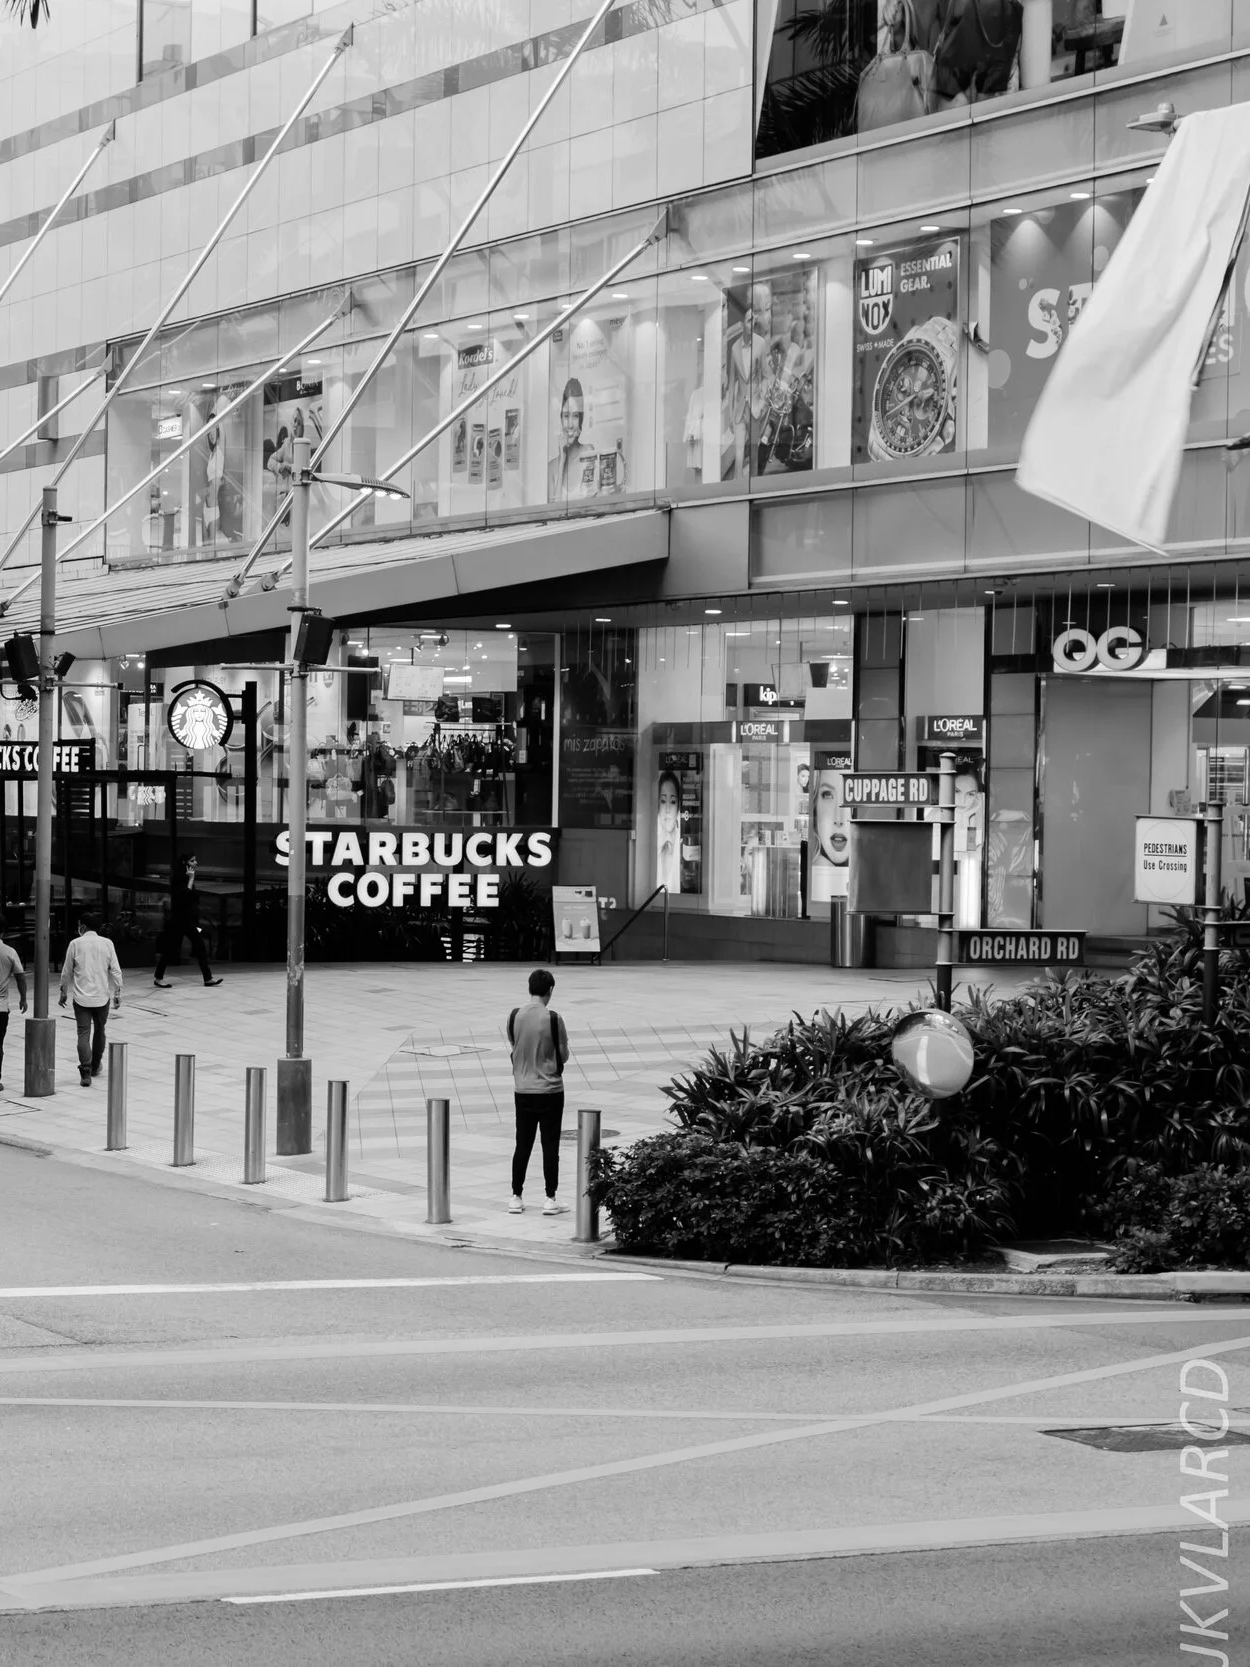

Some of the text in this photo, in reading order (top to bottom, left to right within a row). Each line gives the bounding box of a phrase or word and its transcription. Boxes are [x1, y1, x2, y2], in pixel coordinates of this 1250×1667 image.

[900, 253, 952, 277] ESSENTIAL
[900, 275, 931, 293] GEAR.
[459, 347, 493, 366] Kordel's
[1053, 626, 1142, 672] OG
[24, 745, 80, 772] COFEE
[845, 778, 928, 802] CUPPAGE RD
[275, 831, 552, 867] STARBUCKS
[1144, 843, 1188, 855] PEDESTRIANS
[1143, 859, 1188, 873] Use Crossing
[327, 872, 500, 907] COFFEE
[970, 935, 1079, 960] ORCHARD RD
